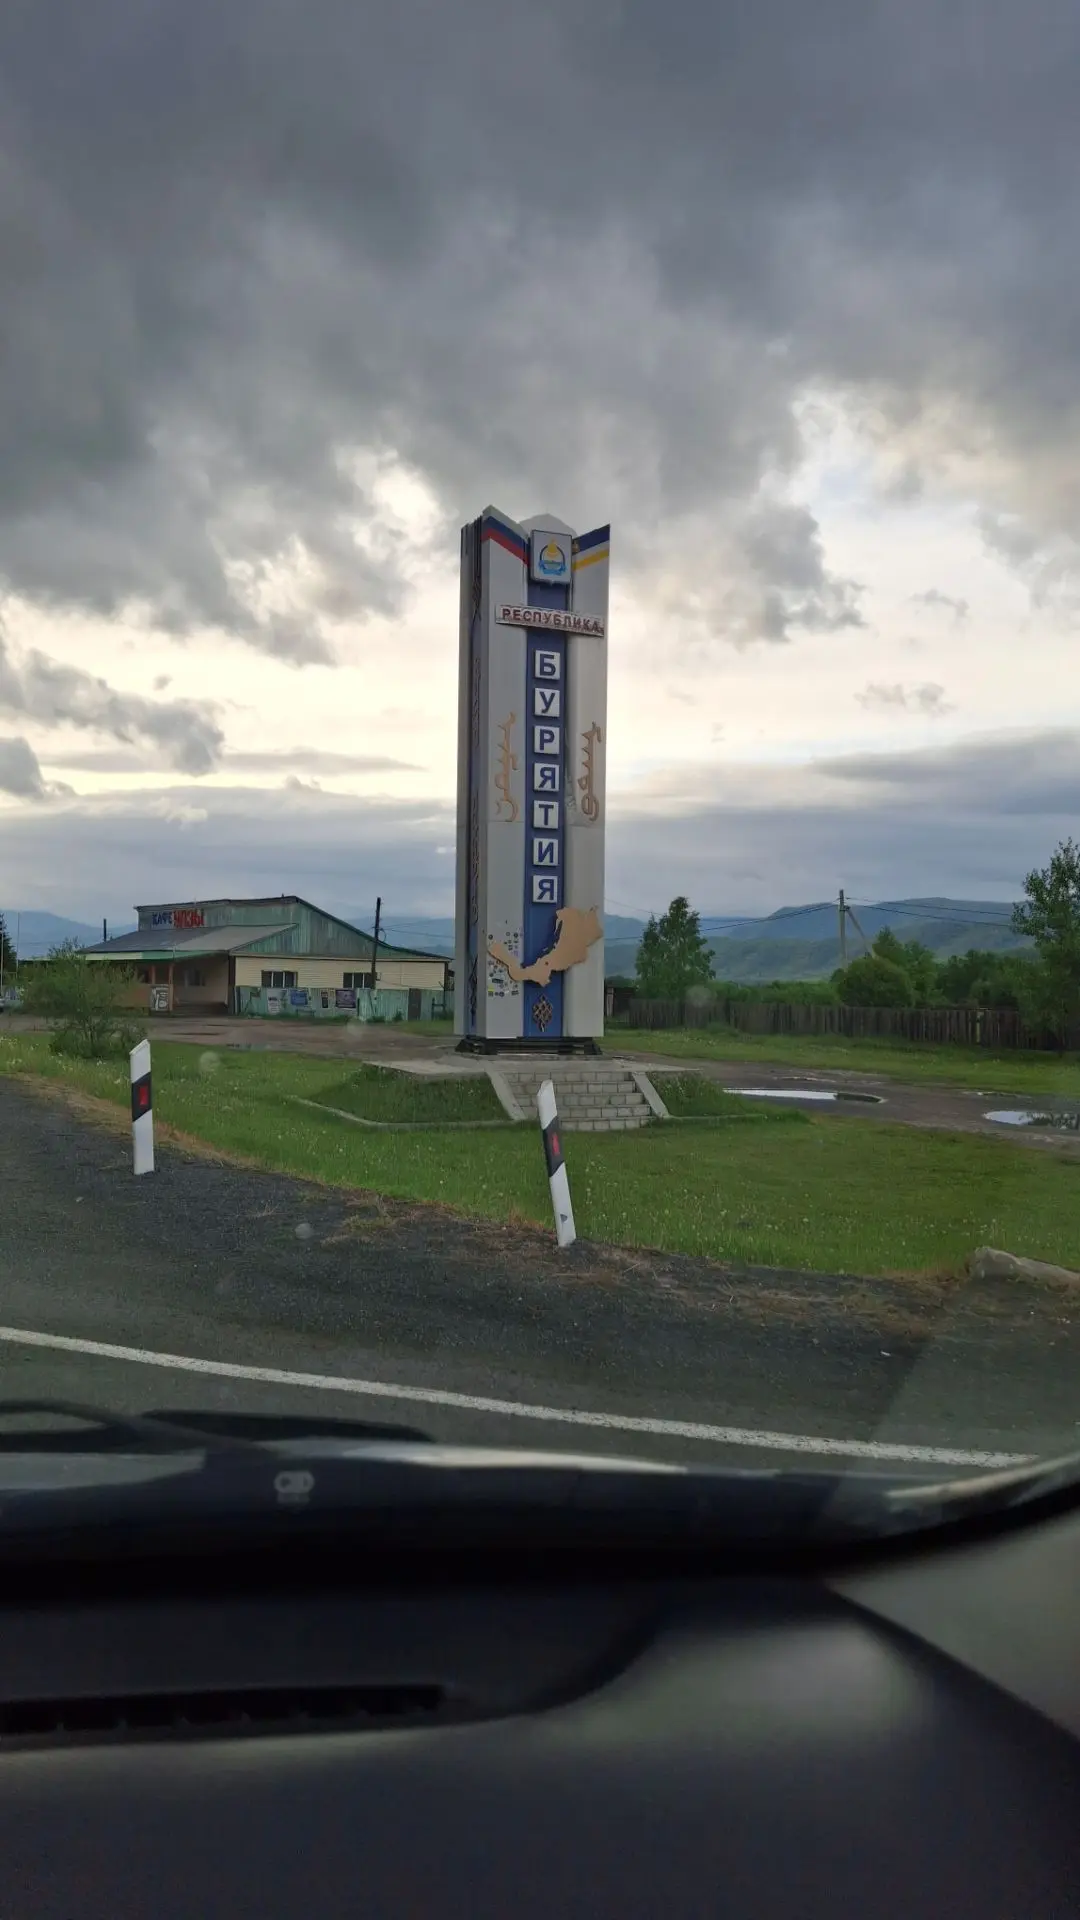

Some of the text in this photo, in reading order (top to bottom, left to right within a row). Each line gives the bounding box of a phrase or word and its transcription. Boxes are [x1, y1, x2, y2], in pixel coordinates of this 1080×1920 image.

[502, 608, 601, 633] РЕСПУБЛИКА
[536, 653, 557, 901] БУРЯТИЯ
[153, 912, 172, 926] КАФЕ
